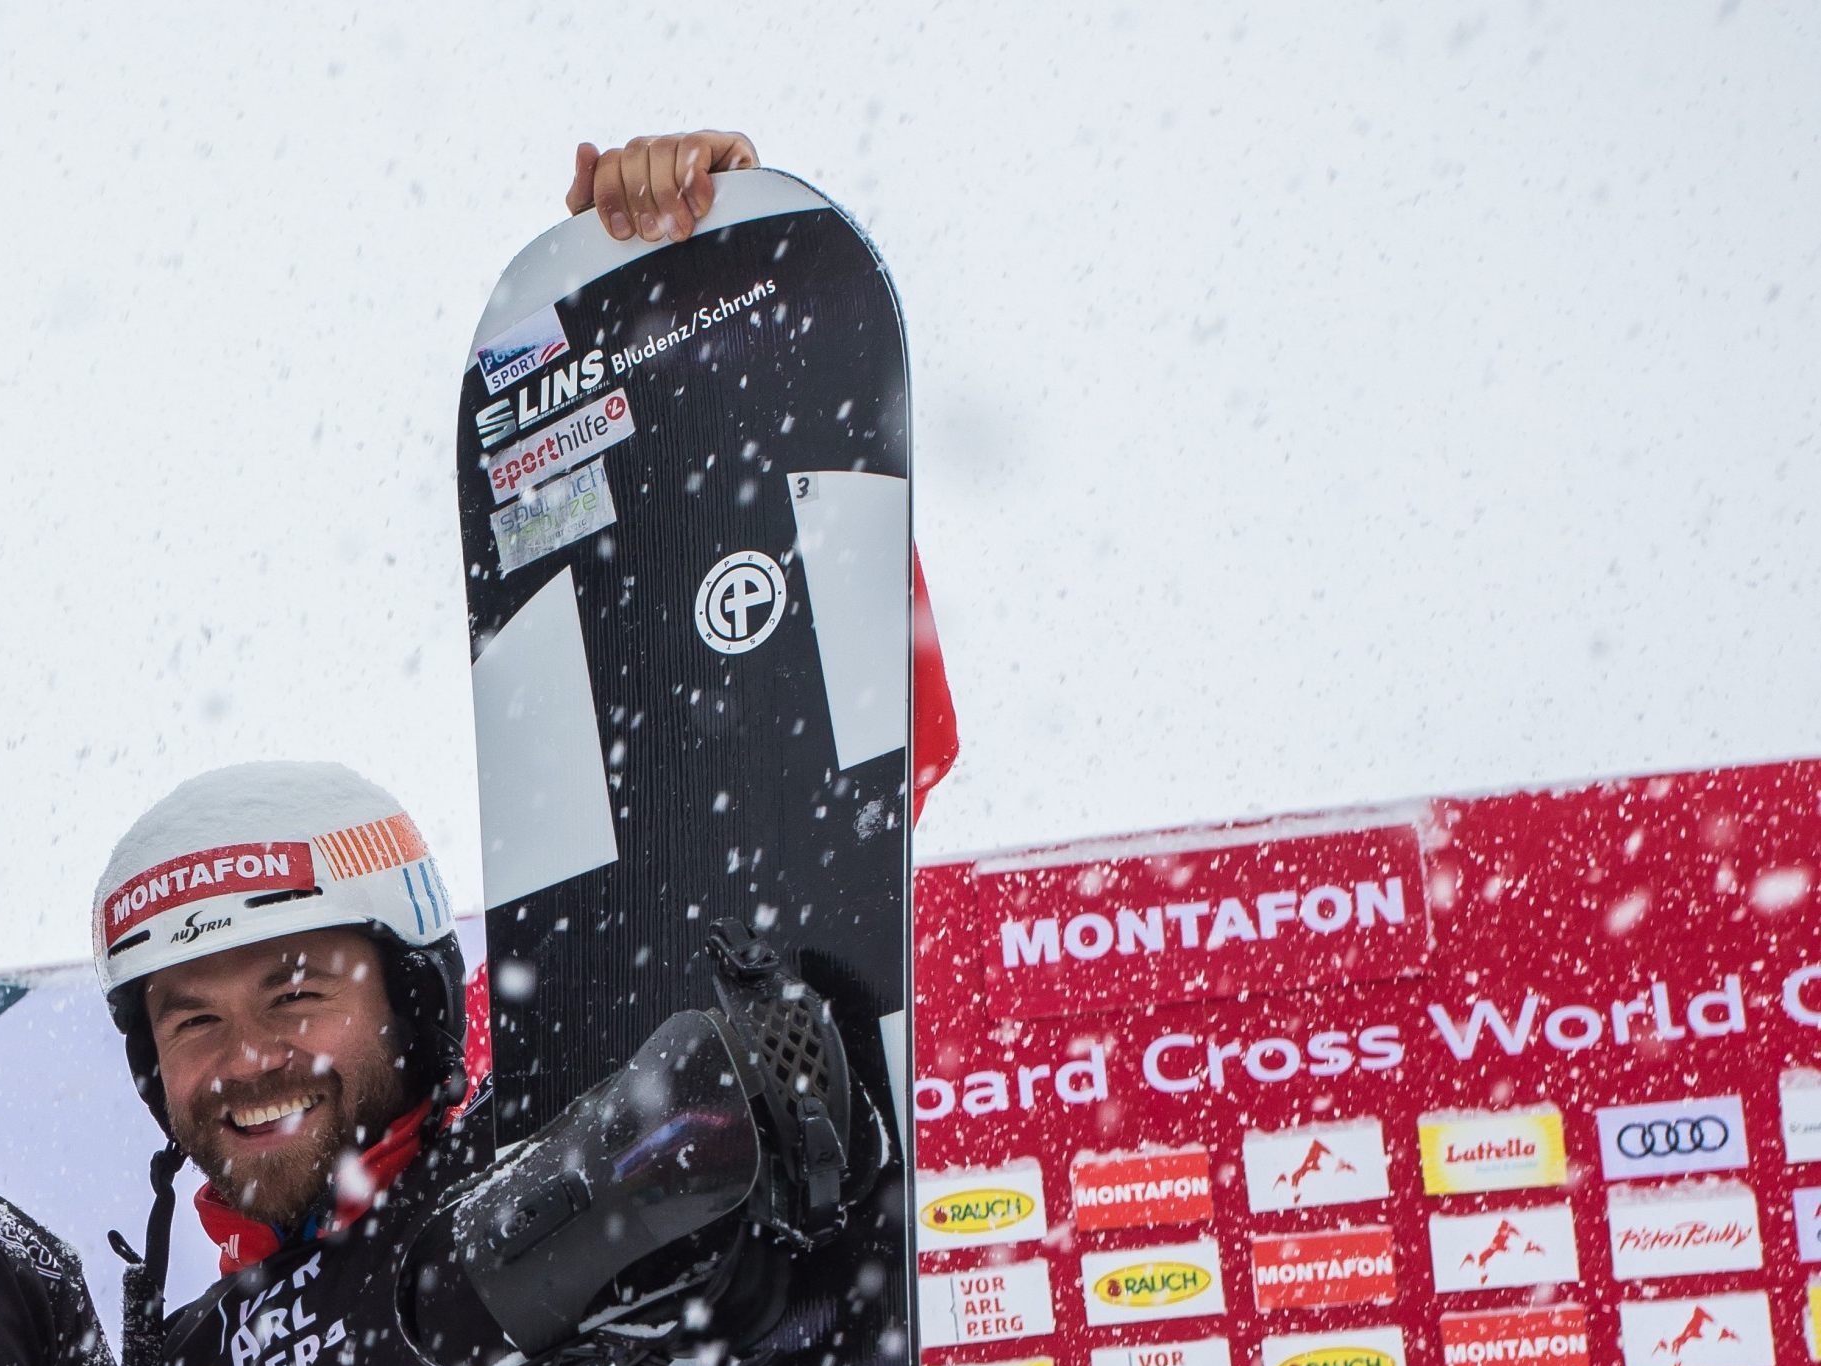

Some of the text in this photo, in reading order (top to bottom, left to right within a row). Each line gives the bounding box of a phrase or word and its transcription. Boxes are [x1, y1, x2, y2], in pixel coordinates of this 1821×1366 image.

[518, 279, 776, 424] LINS Bludenz/Schruns
[491, 352, 538, 390] SPORT
[492, 414, 608, 490] sporthilfe
[796, 476, 810, 499] 3
[704, 553, 775, 588] APEX
[113, 853, 290, 926] MONTAFON
[170, 910, 232, 945] AUSTRIA
[1000, 876, 1406, 969] MONTAFON
[1141, 1024, 1405, 1094] Cross
[1427, 971, 1749, 1063] World
[1444, 1141, 1537, 1165] Lattella
[1077, 1175, 1209, 1206] MONTAFON
[949, 1199, 1022, 1222] RAUCH
[959, 1276, 1006, 1296] VOR
[1123, 1270, 1199, 1295] RAUCH
[1257, 1255, 1394, 1286] MONTAFON
[964, 1297, 1006, 1315] ARL
[966, 1314, 1025, 1337] BERG
[1445, 1332, 1588, 1366] MONTAFON
